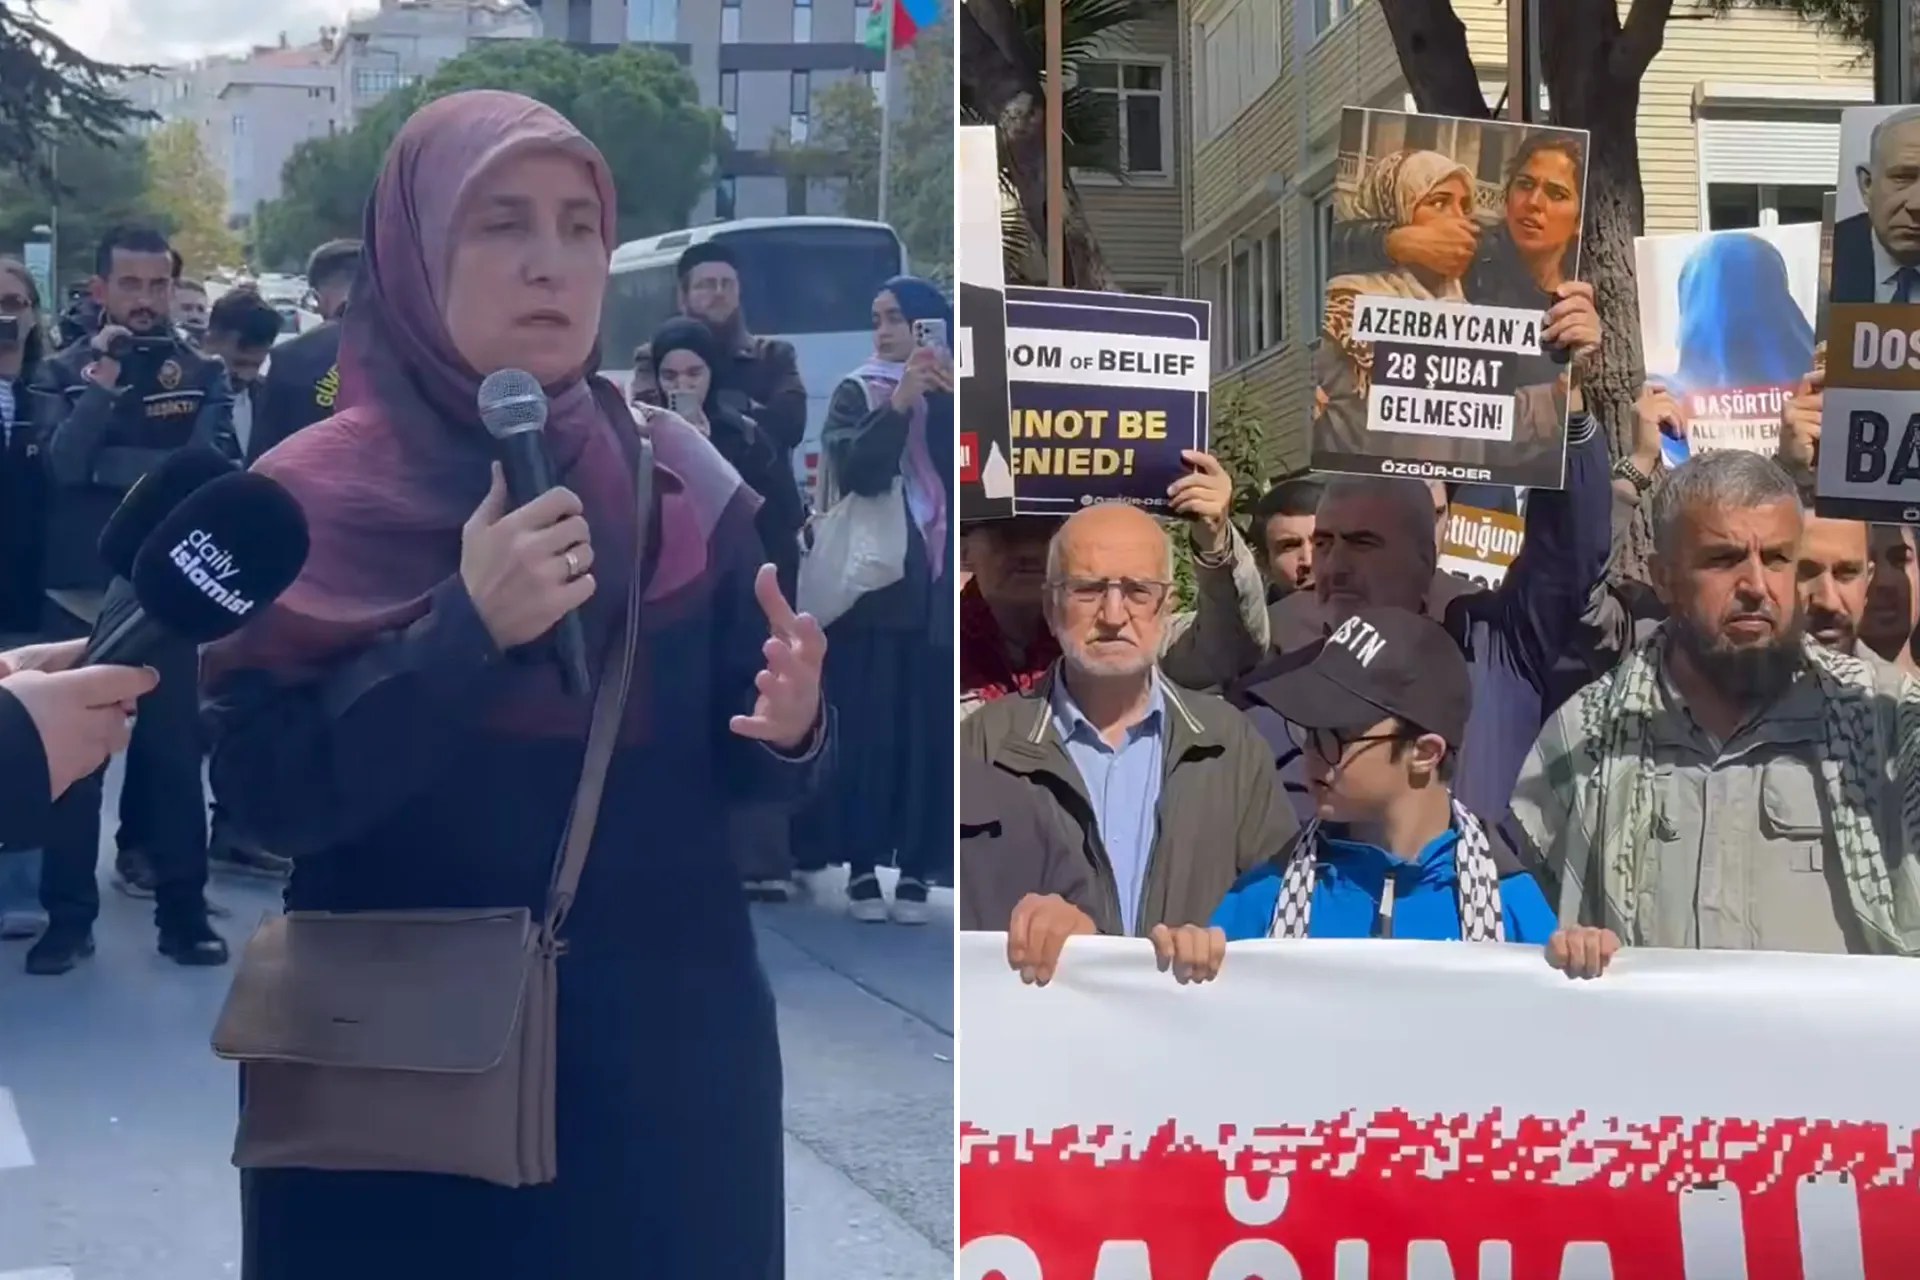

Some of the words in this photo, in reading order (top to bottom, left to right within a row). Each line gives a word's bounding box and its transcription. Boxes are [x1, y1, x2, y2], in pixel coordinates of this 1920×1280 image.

[1357, 306, 1538, 348] AZERBAYCAN'A
[1008, 345, 1062, 370] OM
[1069, 356, 1094, 371] OF
[1099, 349, 1195, 376] BELIEF
[1385, 352, 1417, 380] 28
[1423, 354, 1503, 389] ŞUBAT
[1118, 410, 1168, 440] BE
[1380, 395, 1503, 430] GELMESİN!
[1381, 460, 1492, 481] ÖZGÜR-DER
[188, 529, 241, 581] daily
[168, 539, 255, 616] islamist
